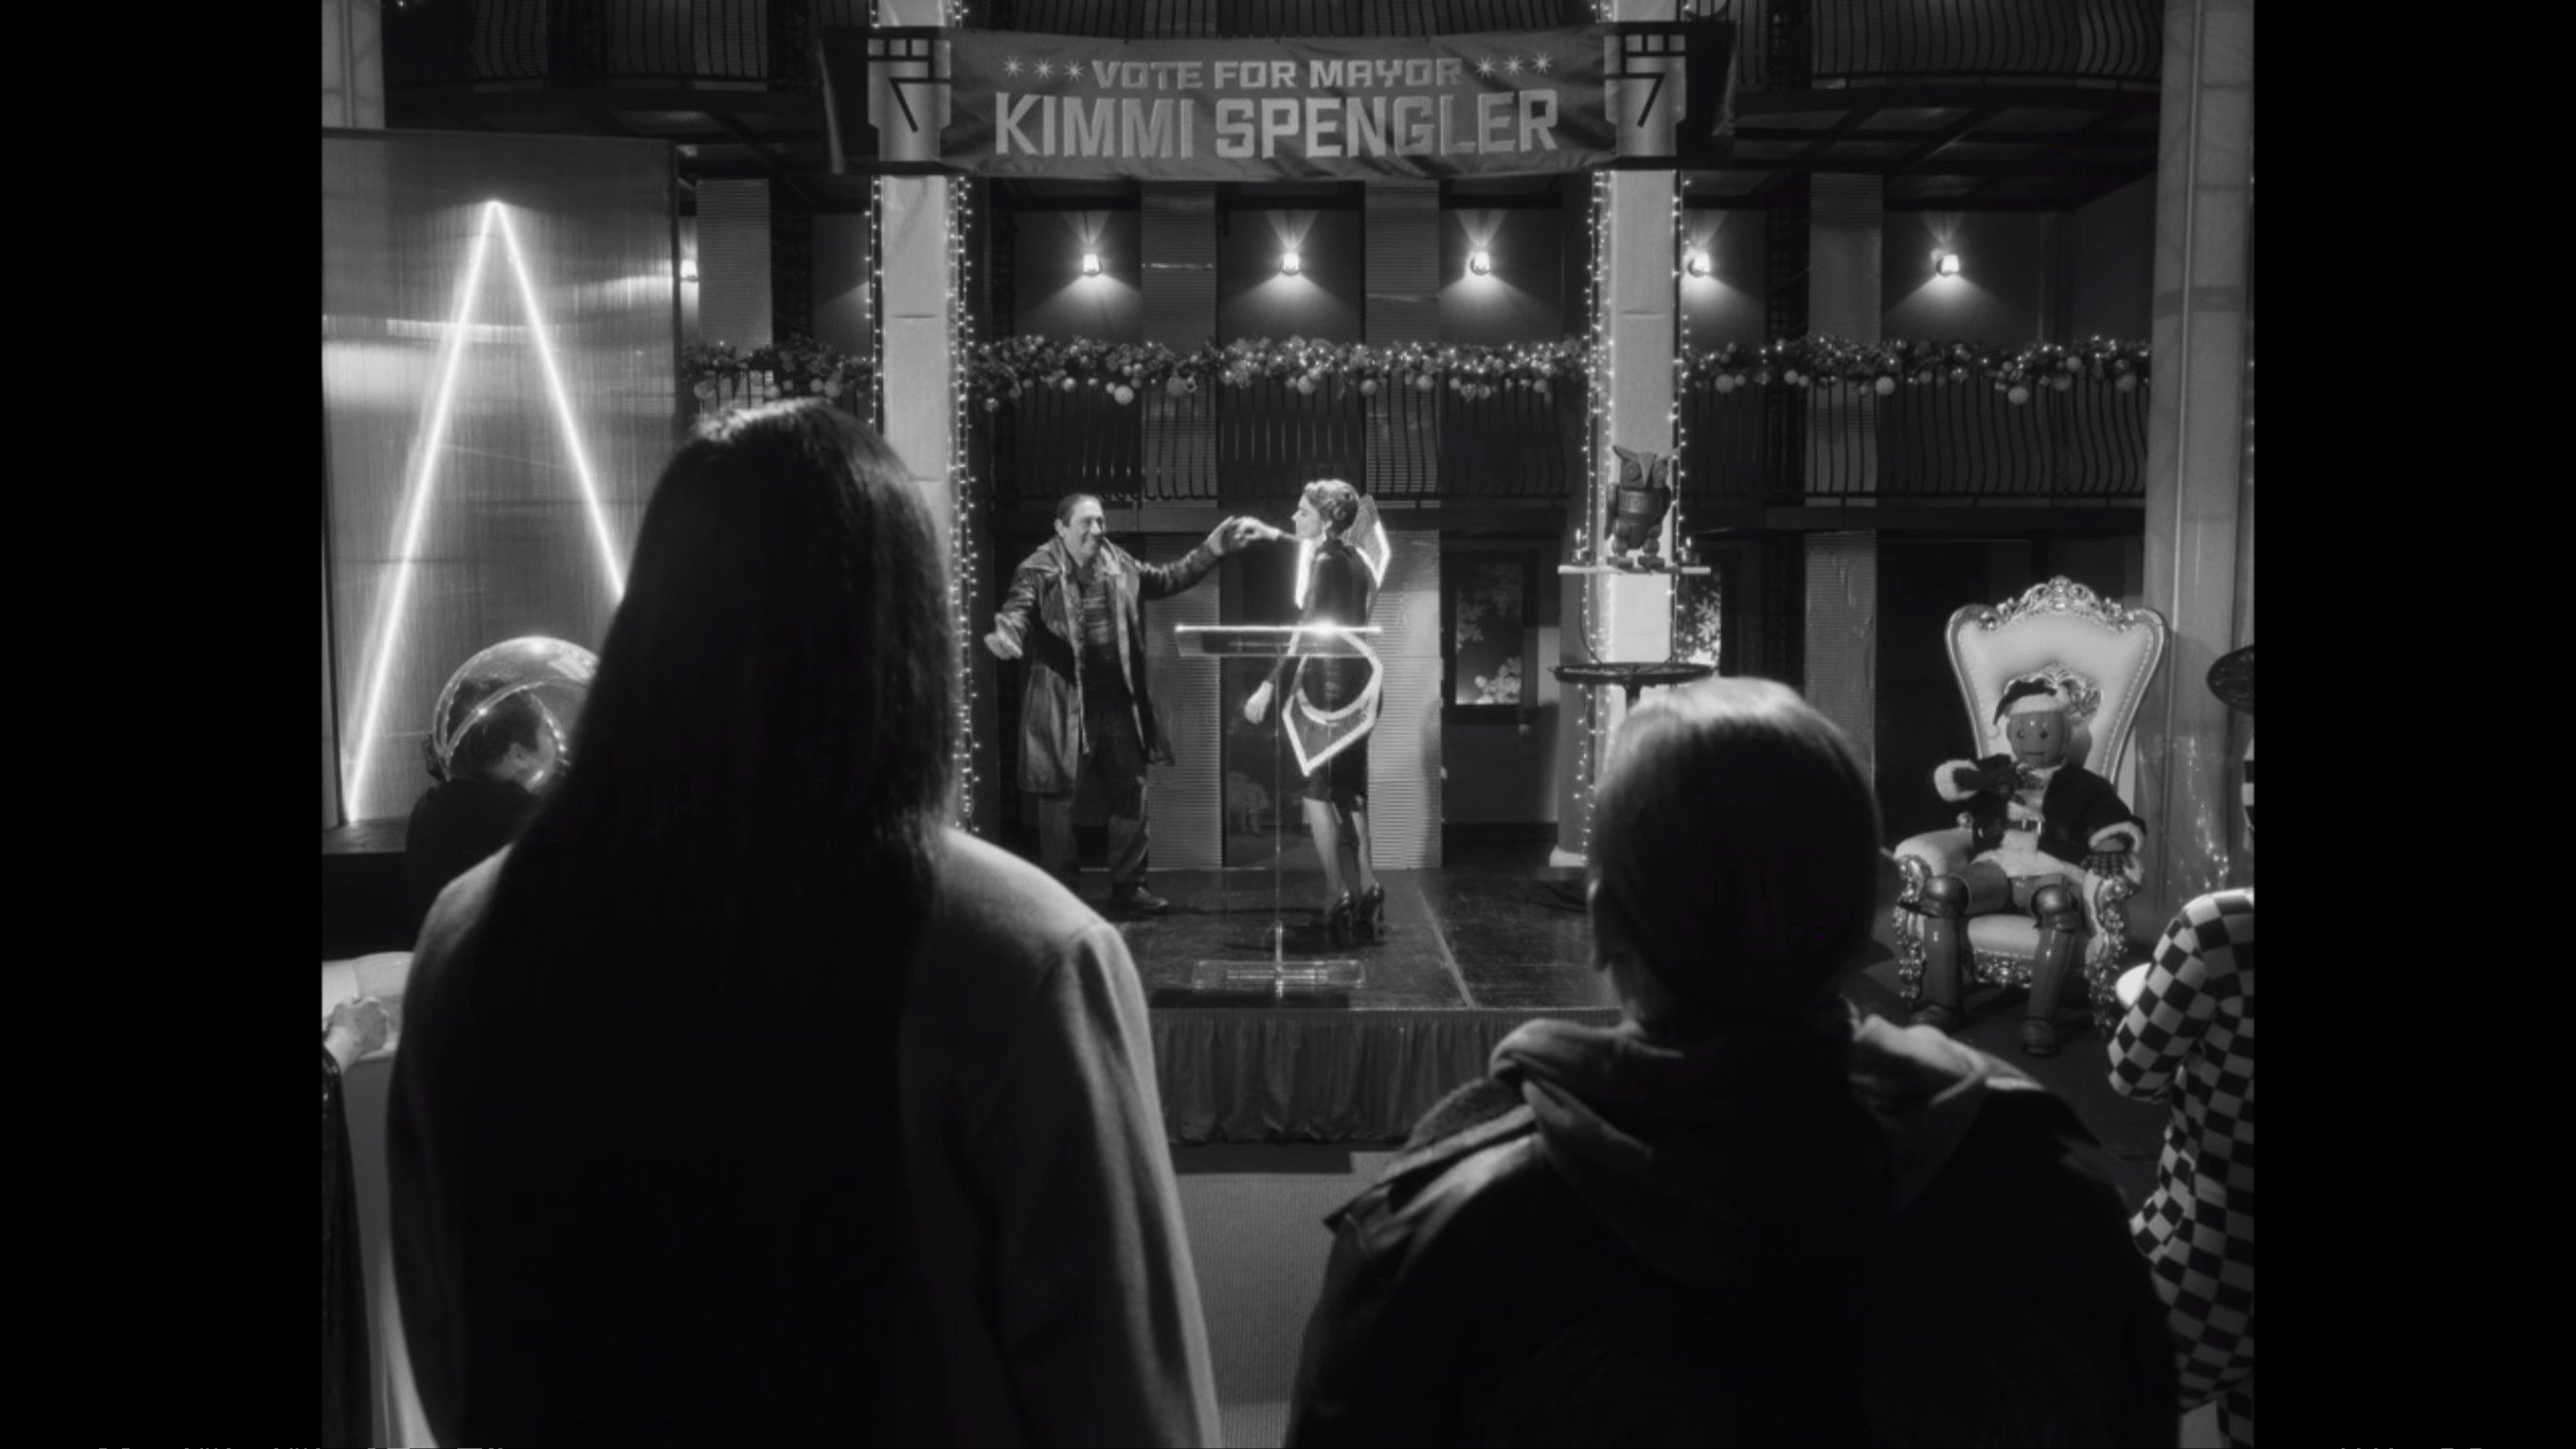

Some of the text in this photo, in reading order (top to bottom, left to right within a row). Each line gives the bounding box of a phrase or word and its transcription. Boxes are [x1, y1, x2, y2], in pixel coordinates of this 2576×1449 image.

[1092, 58, 1463, 90] VOTE FOR MAYOR
[996, 90, 1559, 159] KIMMI SPENGLER
